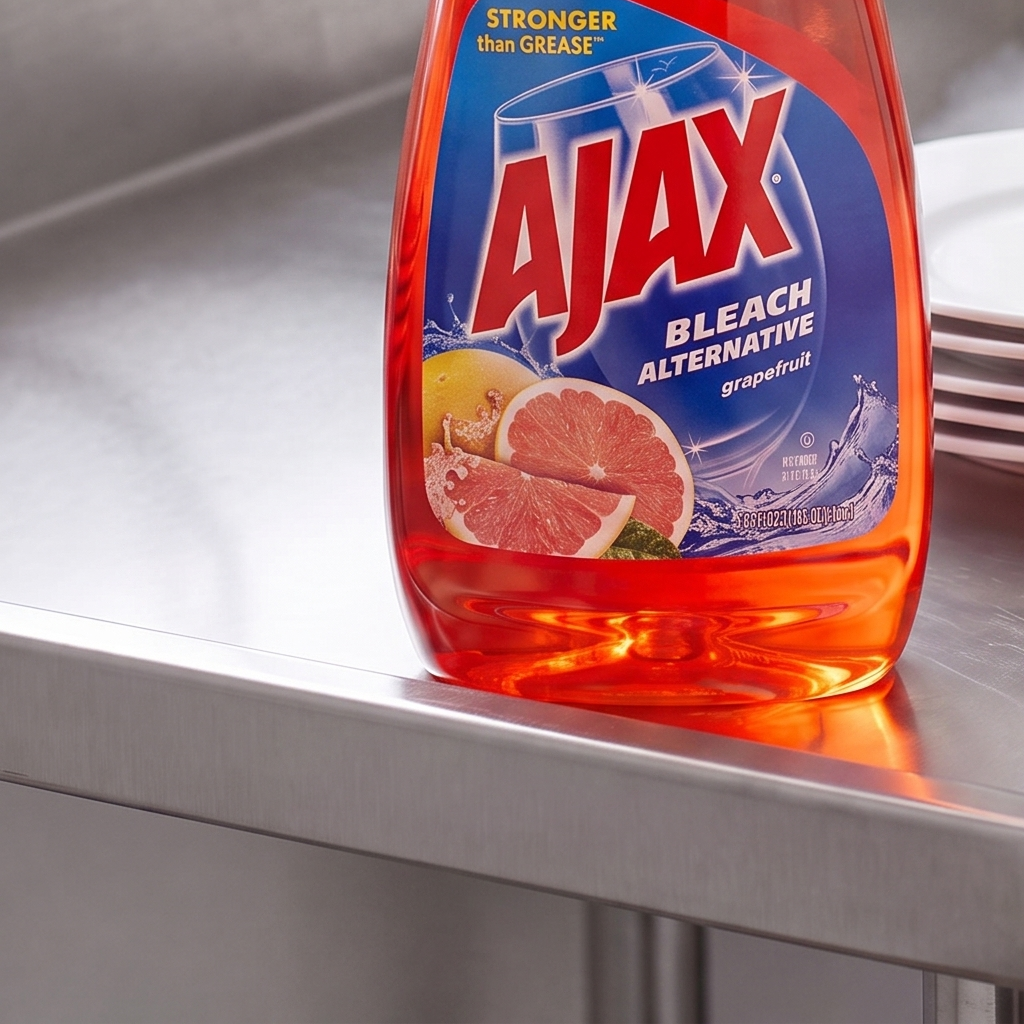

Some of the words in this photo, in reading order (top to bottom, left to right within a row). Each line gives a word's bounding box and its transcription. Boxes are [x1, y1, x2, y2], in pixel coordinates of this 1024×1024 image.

[477, 34, 515, 53] than
[486, 8, 617, 31] STRONGER
[471, 88, 793, 357] AJAX
[665, 277, 812, 349] BLEACH
[637, 311, 815, 386] ALTERNATIVE
[721, 350, 812, 398] grapefruit
